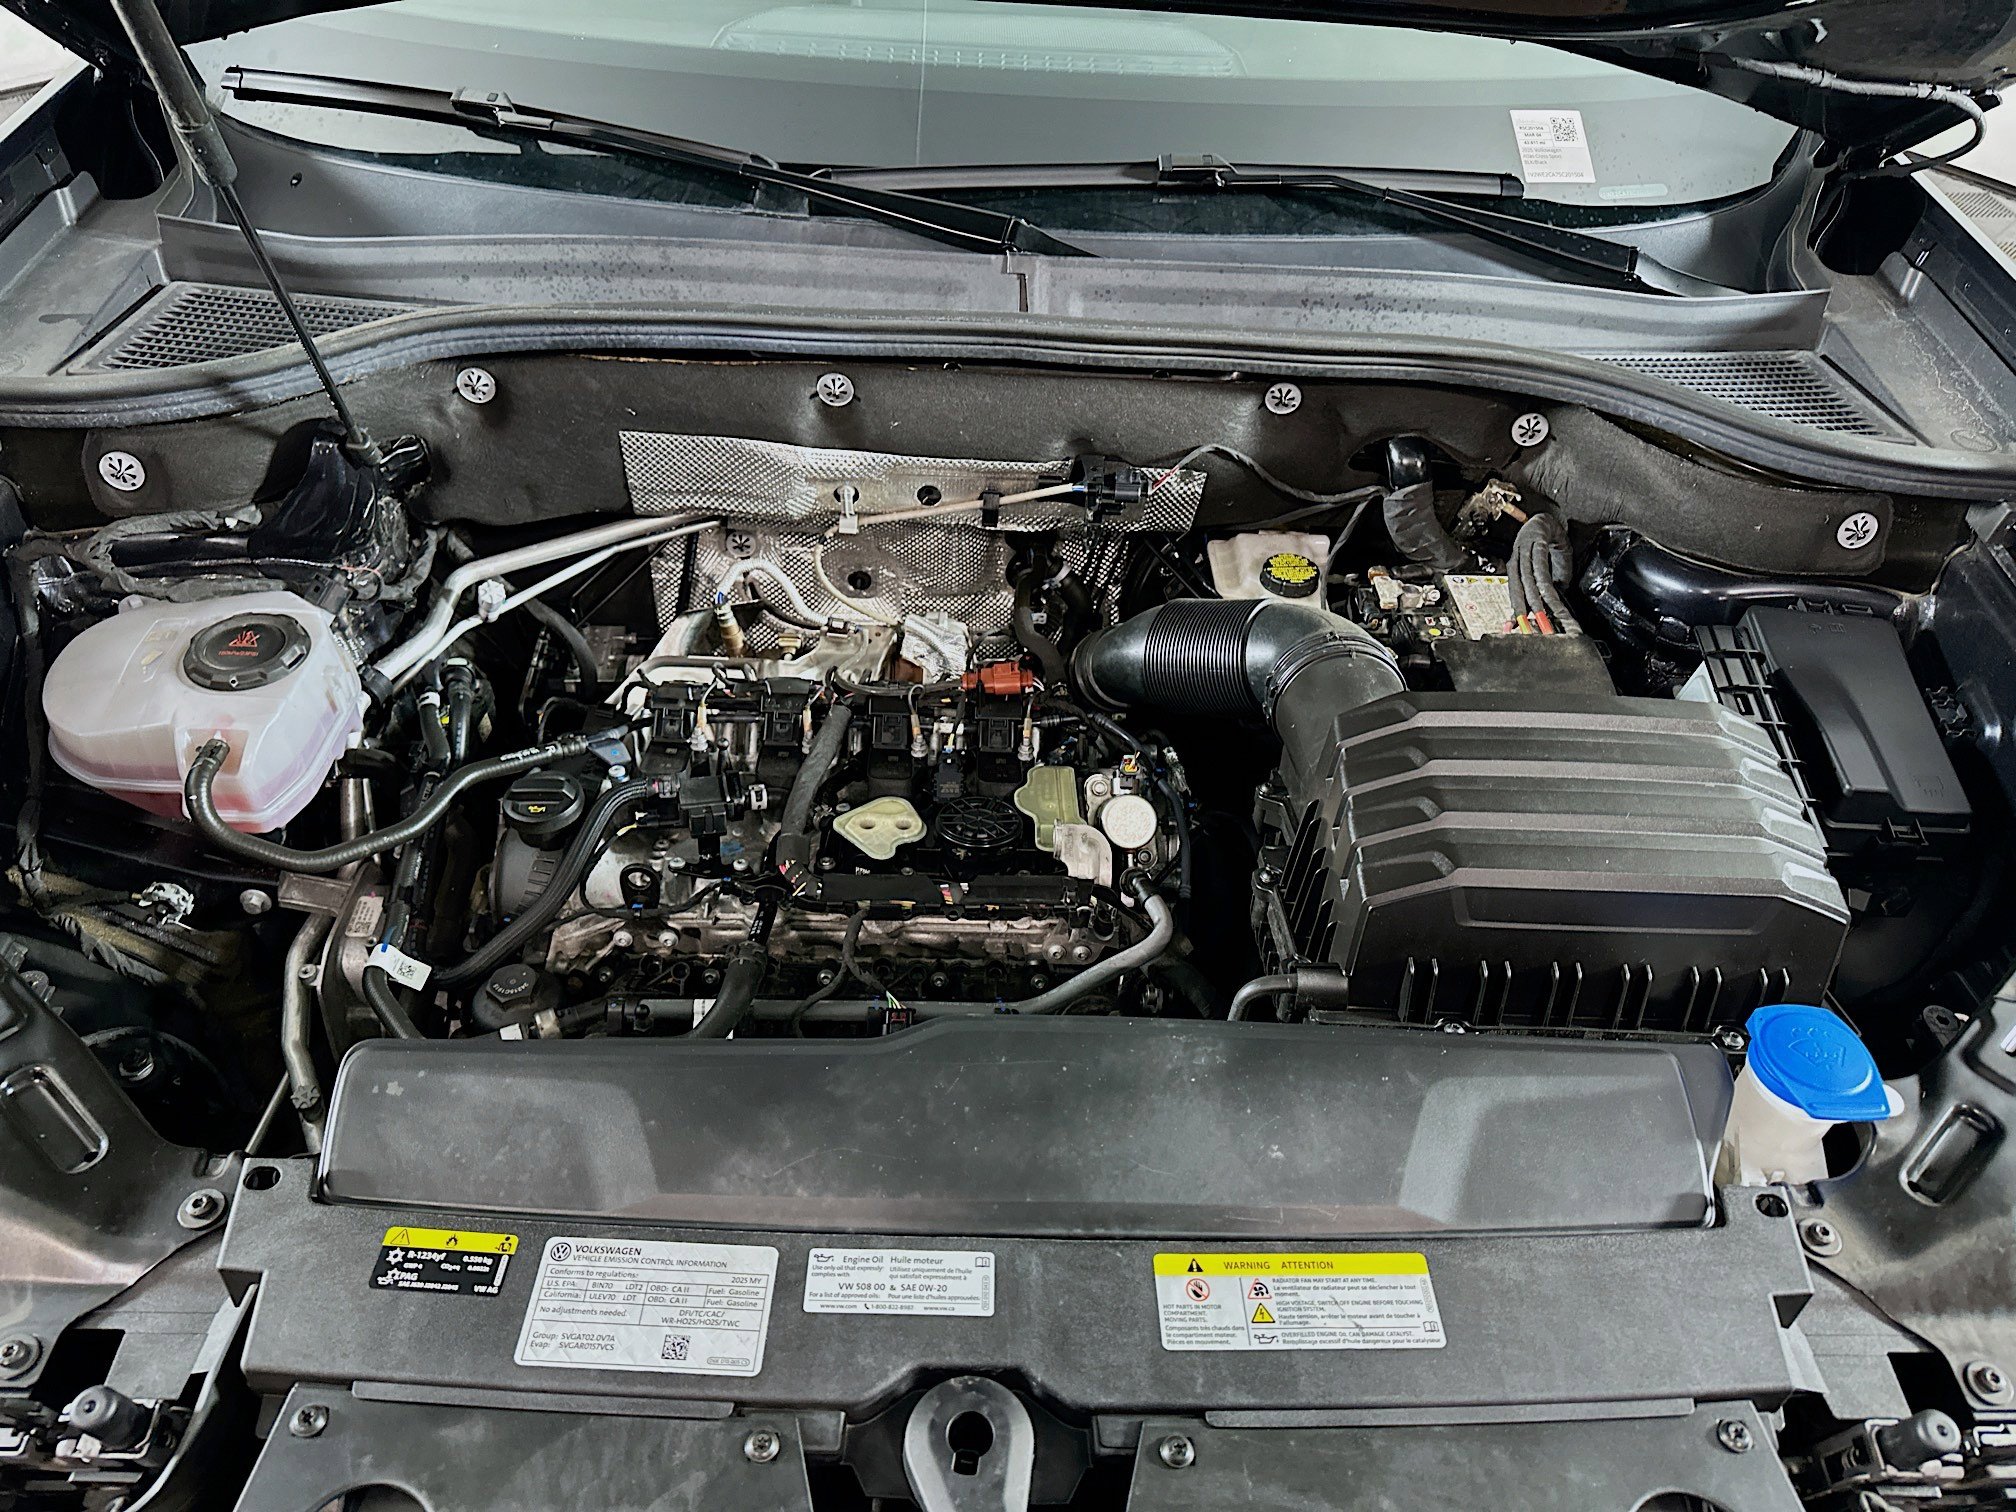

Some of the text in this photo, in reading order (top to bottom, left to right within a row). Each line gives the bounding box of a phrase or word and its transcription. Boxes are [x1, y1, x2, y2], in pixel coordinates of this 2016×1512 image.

[575, 1245, 641, 1255] VOLKSWAGEN
[407, 1250, 447, 1262] R-1234yf
[843, 1256, 870, 1264] Engine
[604, 1256, 639, 1264] EMISSION
[640, 1257, 674, 1266] CONTROL
[676, 1260, 728, 1268] INFORMATION
[1224, 1261, 1334, 1270] WARNING ATTENTION
[399, 1272, 418, 1281] PAG
[596, 1270, 639, 1279] regulations:
[729, 1288, 760, 1296] Gasoline
[552, 1306, 598, 1315] adjustments
[679, 1310, 725, 1318] DFI/TC/CAC/
[533, 1332, 559, 1340] Group:
